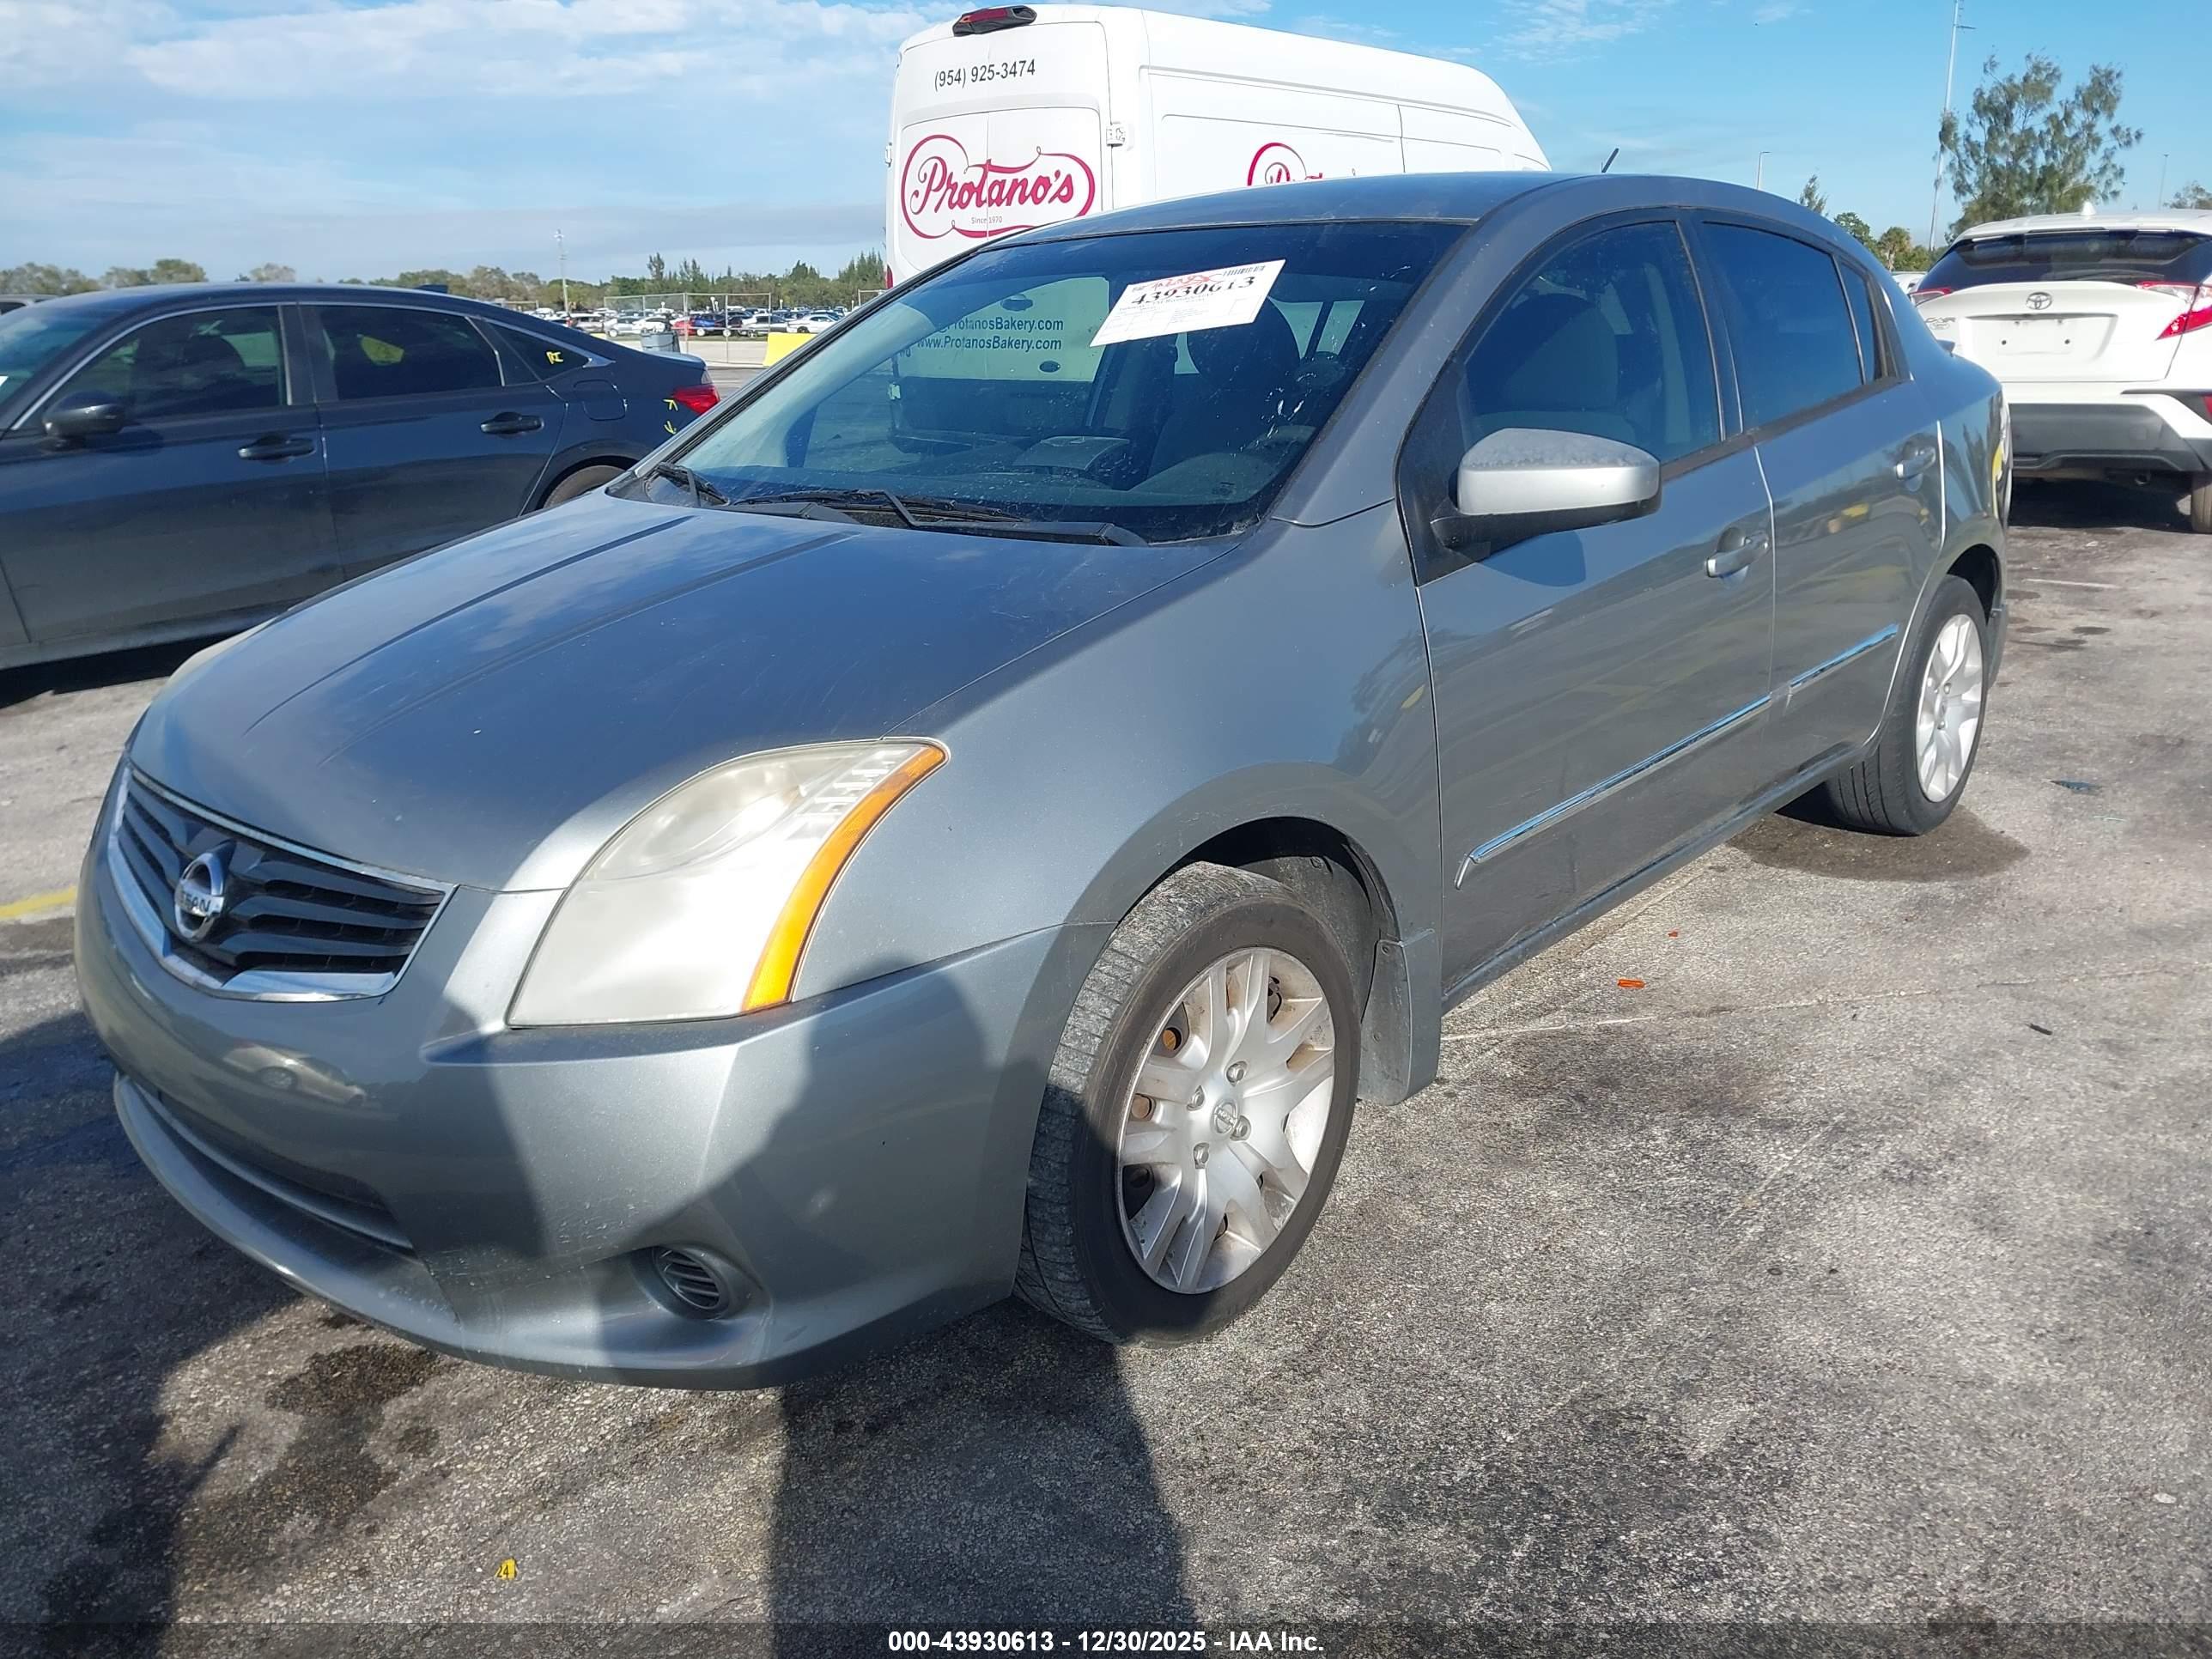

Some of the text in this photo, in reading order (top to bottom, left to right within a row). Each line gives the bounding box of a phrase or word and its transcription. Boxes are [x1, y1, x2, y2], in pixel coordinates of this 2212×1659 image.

[934, 58, 1036, 91] (954) 925-3474
[909, 156, 1074, 215] Protano's
[971, 216, 1003, 225] Since 1970
[1131, 276, 1255, 305] 43930613
[939, 317, 1064, 333] rotanosBakery.com
